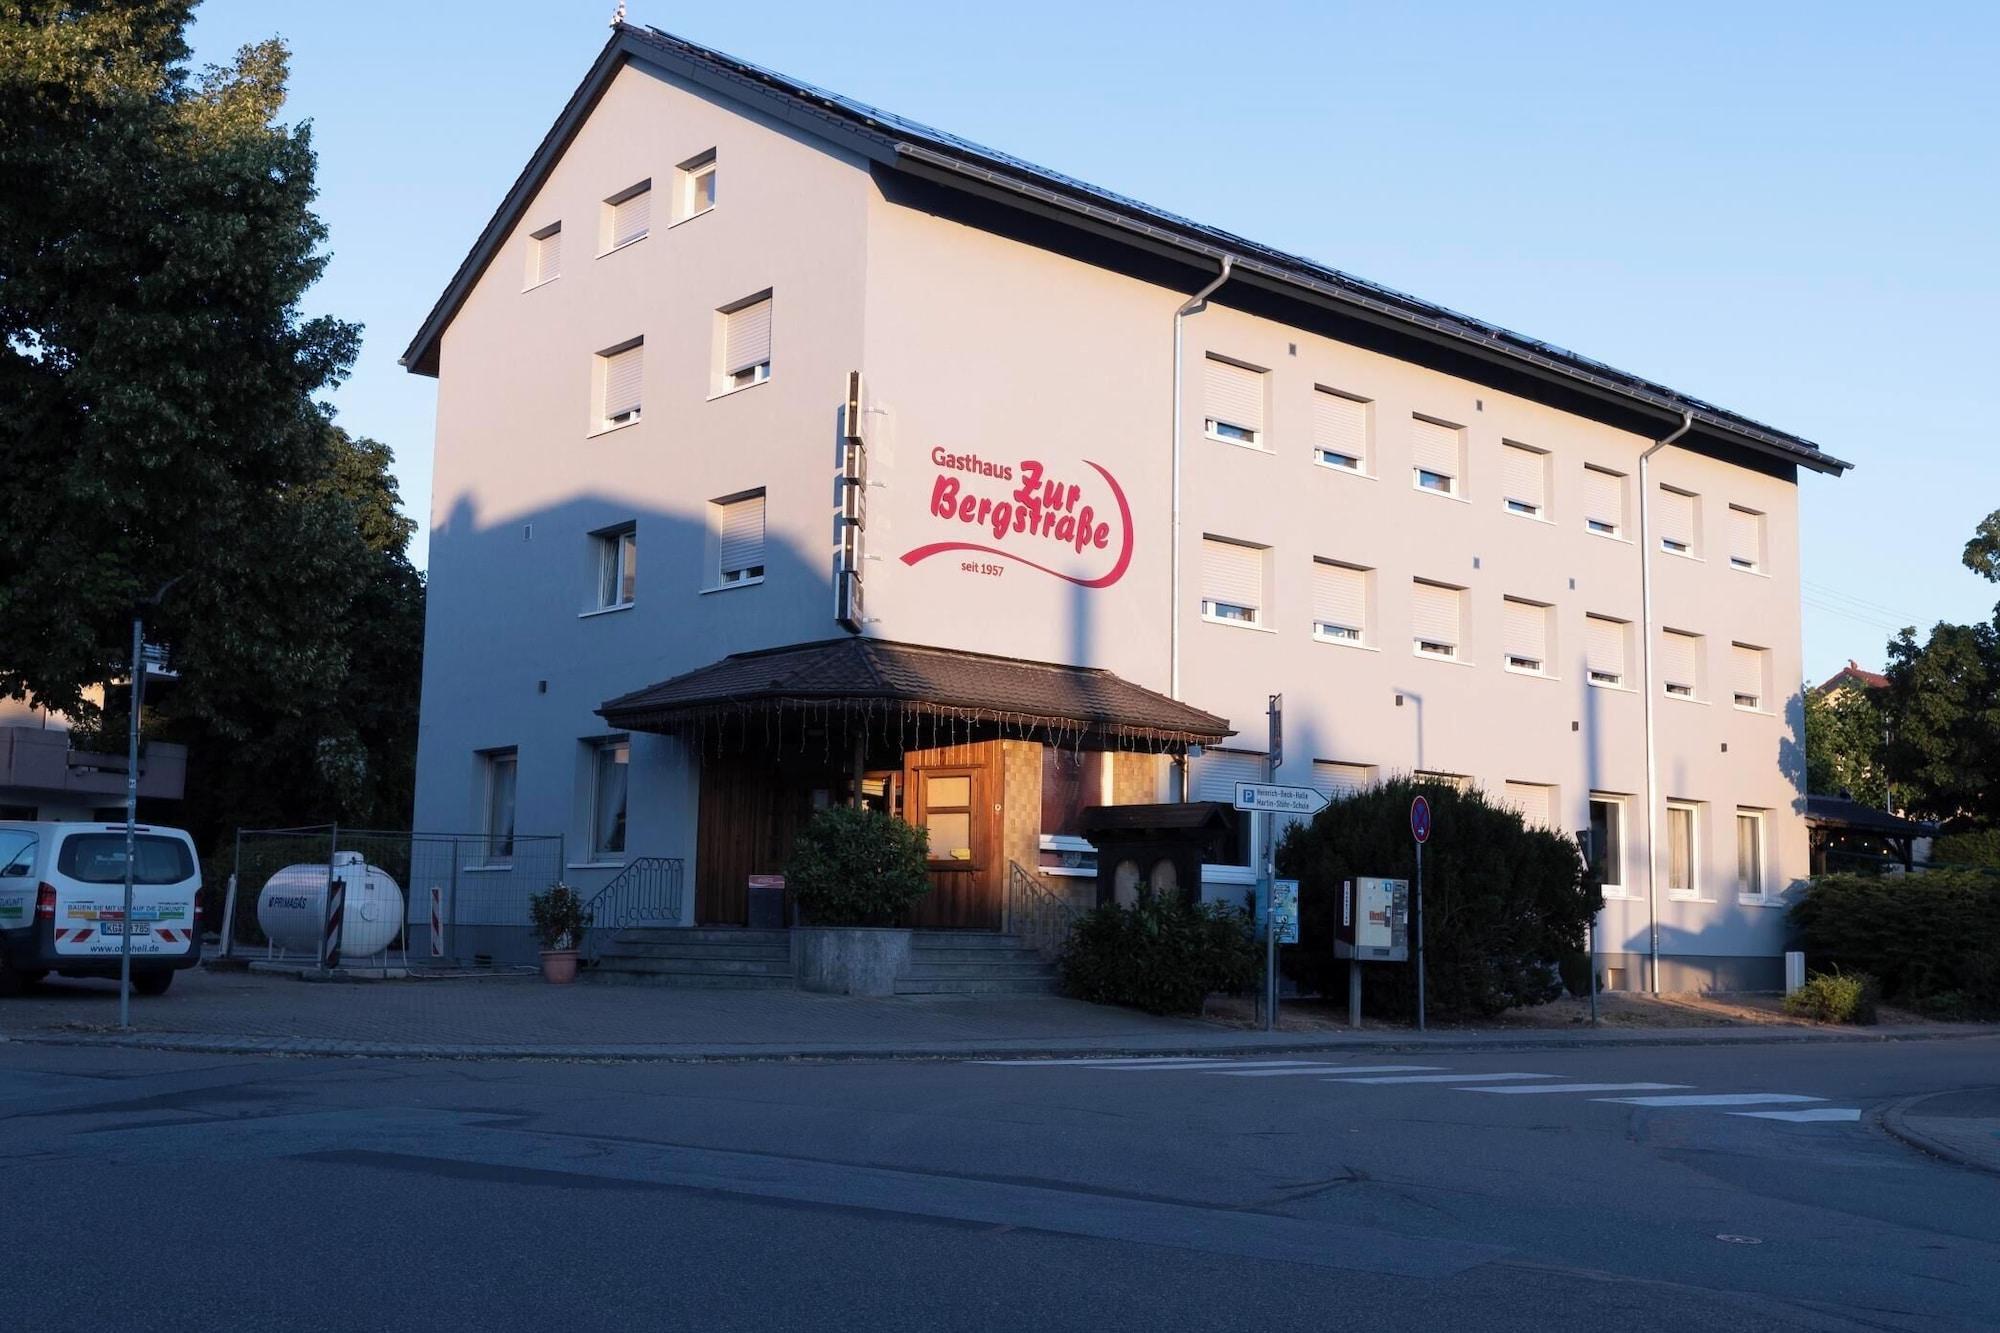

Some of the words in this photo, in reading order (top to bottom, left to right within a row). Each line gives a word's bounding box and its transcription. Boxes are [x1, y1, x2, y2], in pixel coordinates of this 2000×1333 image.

[931, 446, 1012, 481] Gasthaus
[1013, 460, 1081, 513] Zur
[930, 474, 1110, 554] Bergstraße
[961, 560, 979, 574] seit
[980, 562, 1004, 577] 1957
